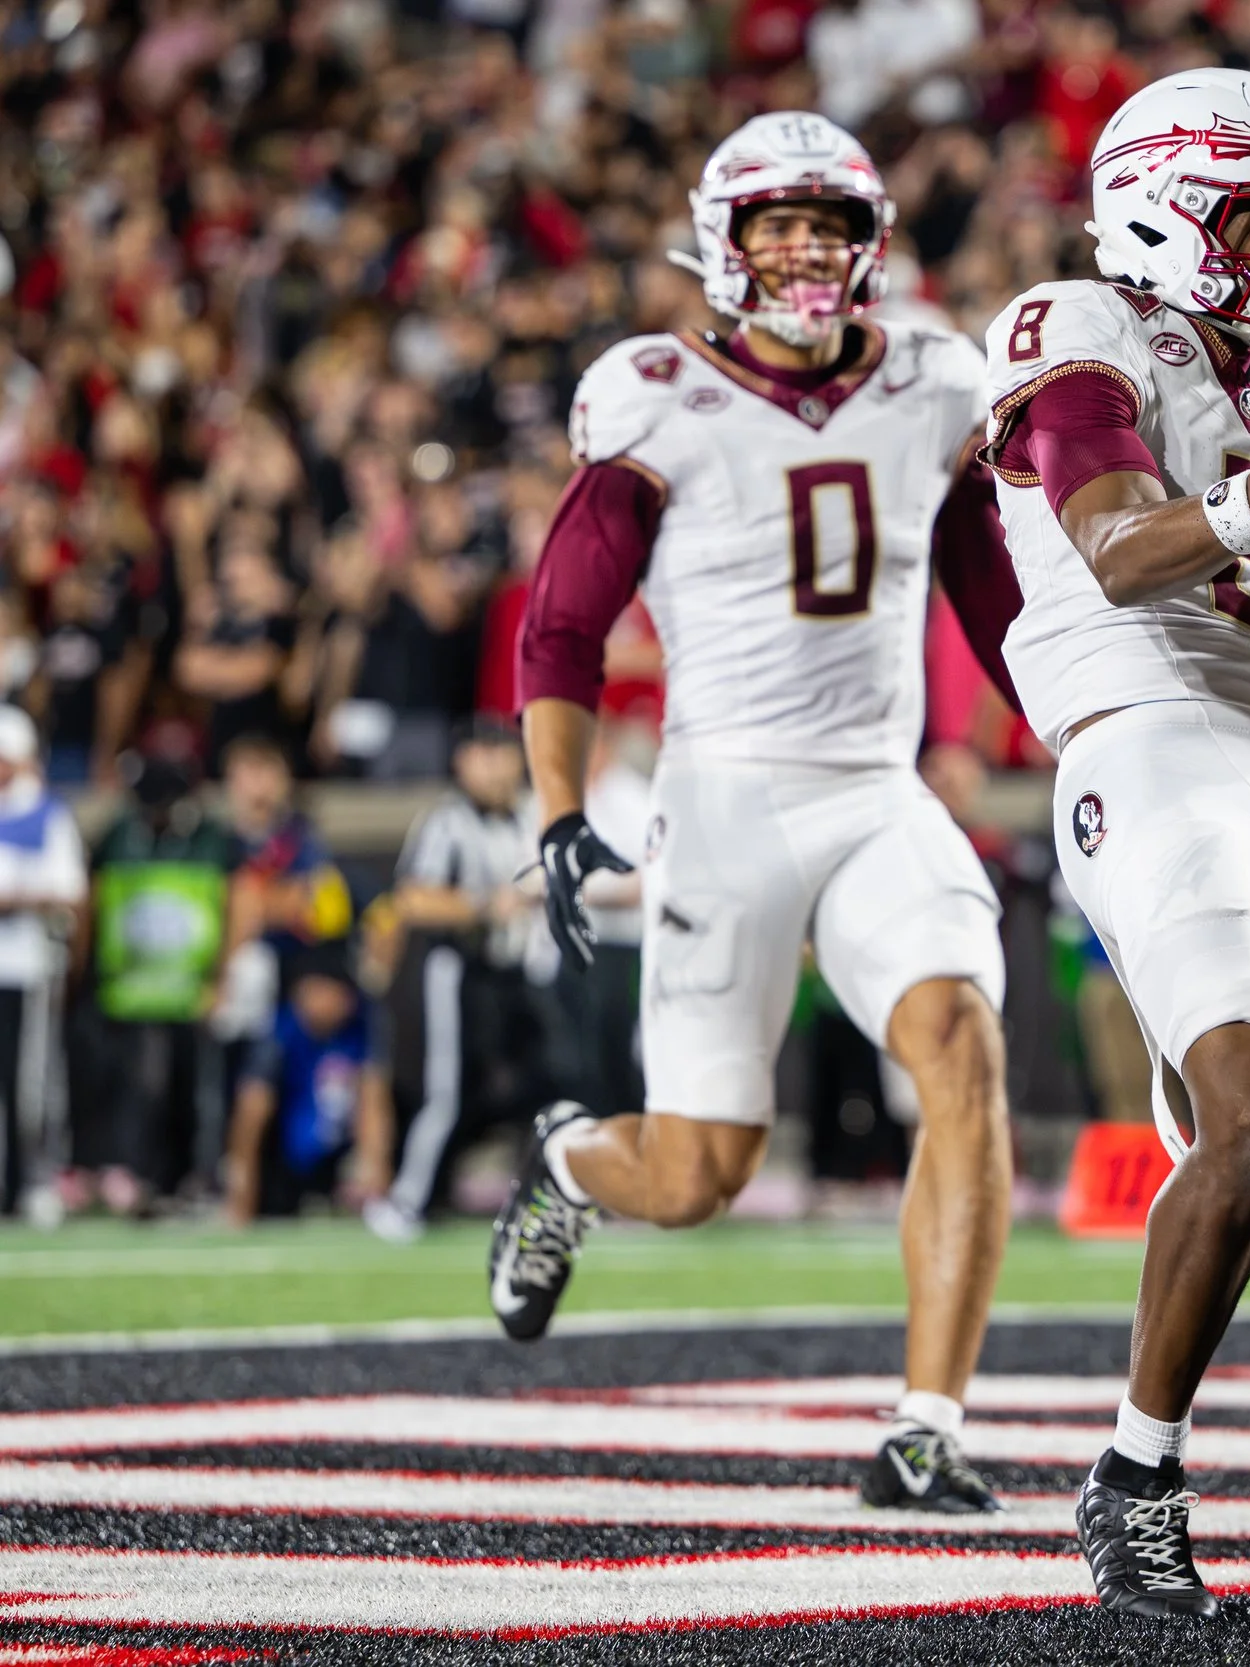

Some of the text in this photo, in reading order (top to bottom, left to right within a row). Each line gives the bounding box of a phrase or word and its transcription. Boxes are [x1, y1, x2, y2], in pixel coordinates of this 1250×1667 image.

[1008, 299, 1055, 364] 8
[1156, 340, 1190, 354] ACC
[783, 458, 882, 619] 0
